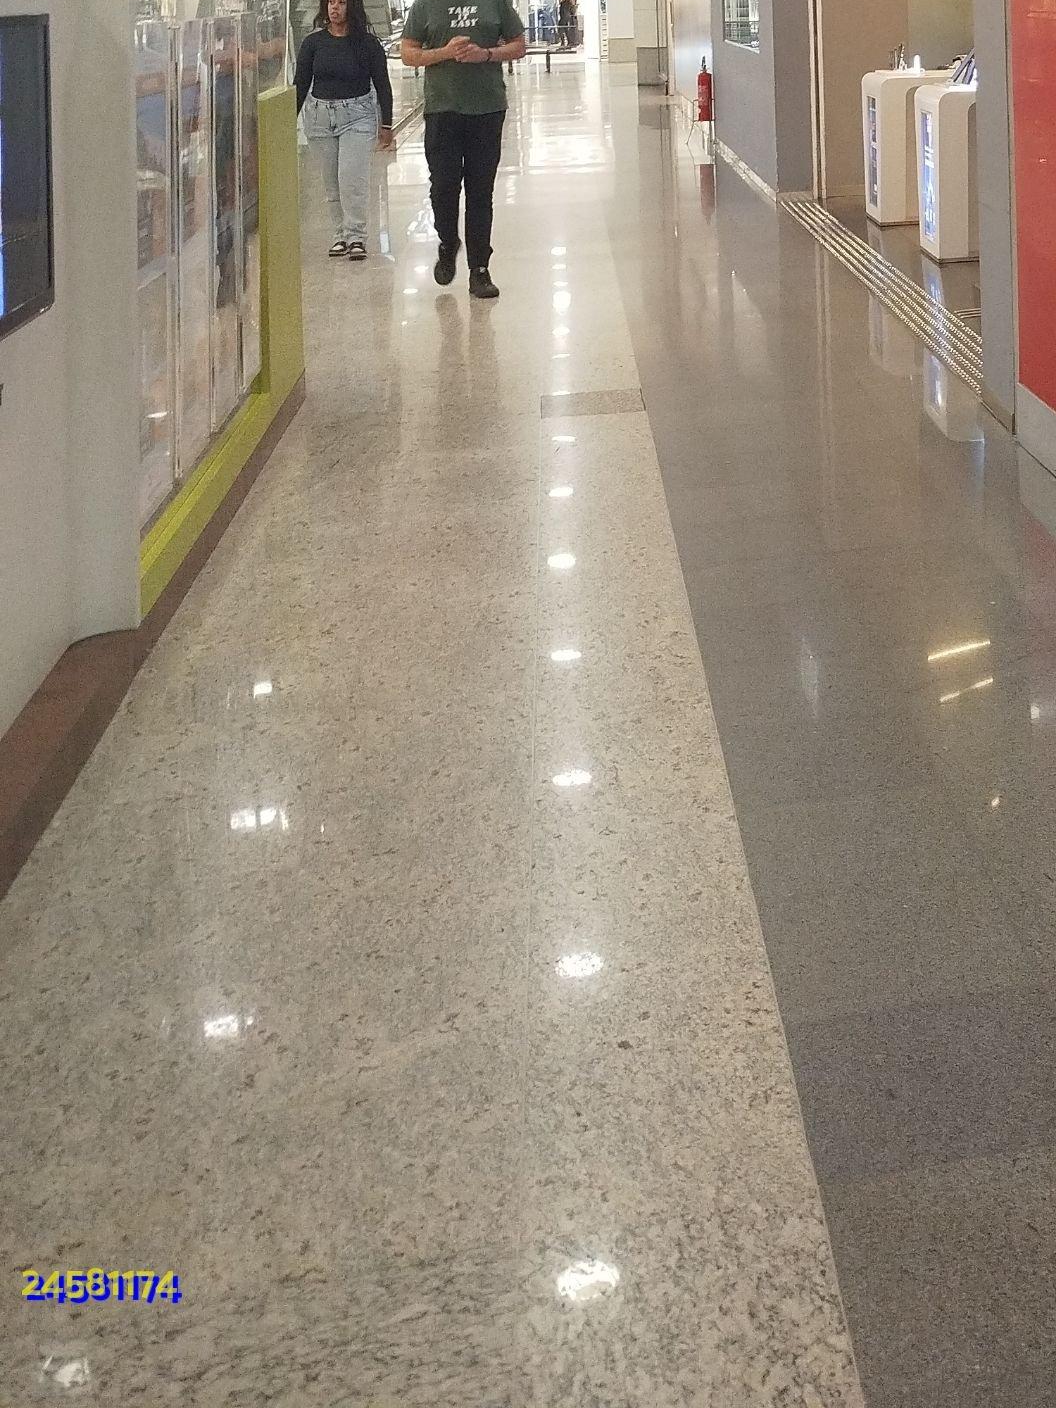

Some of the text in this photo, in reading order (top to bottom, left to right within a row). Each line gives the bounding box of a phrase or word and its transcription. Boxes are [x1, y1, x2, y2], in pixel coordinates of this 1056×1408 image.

[447, 5, 478, 15] TAKE
[457, 12, 469, 21] IT
[450, 17, 479, 28] EASY
